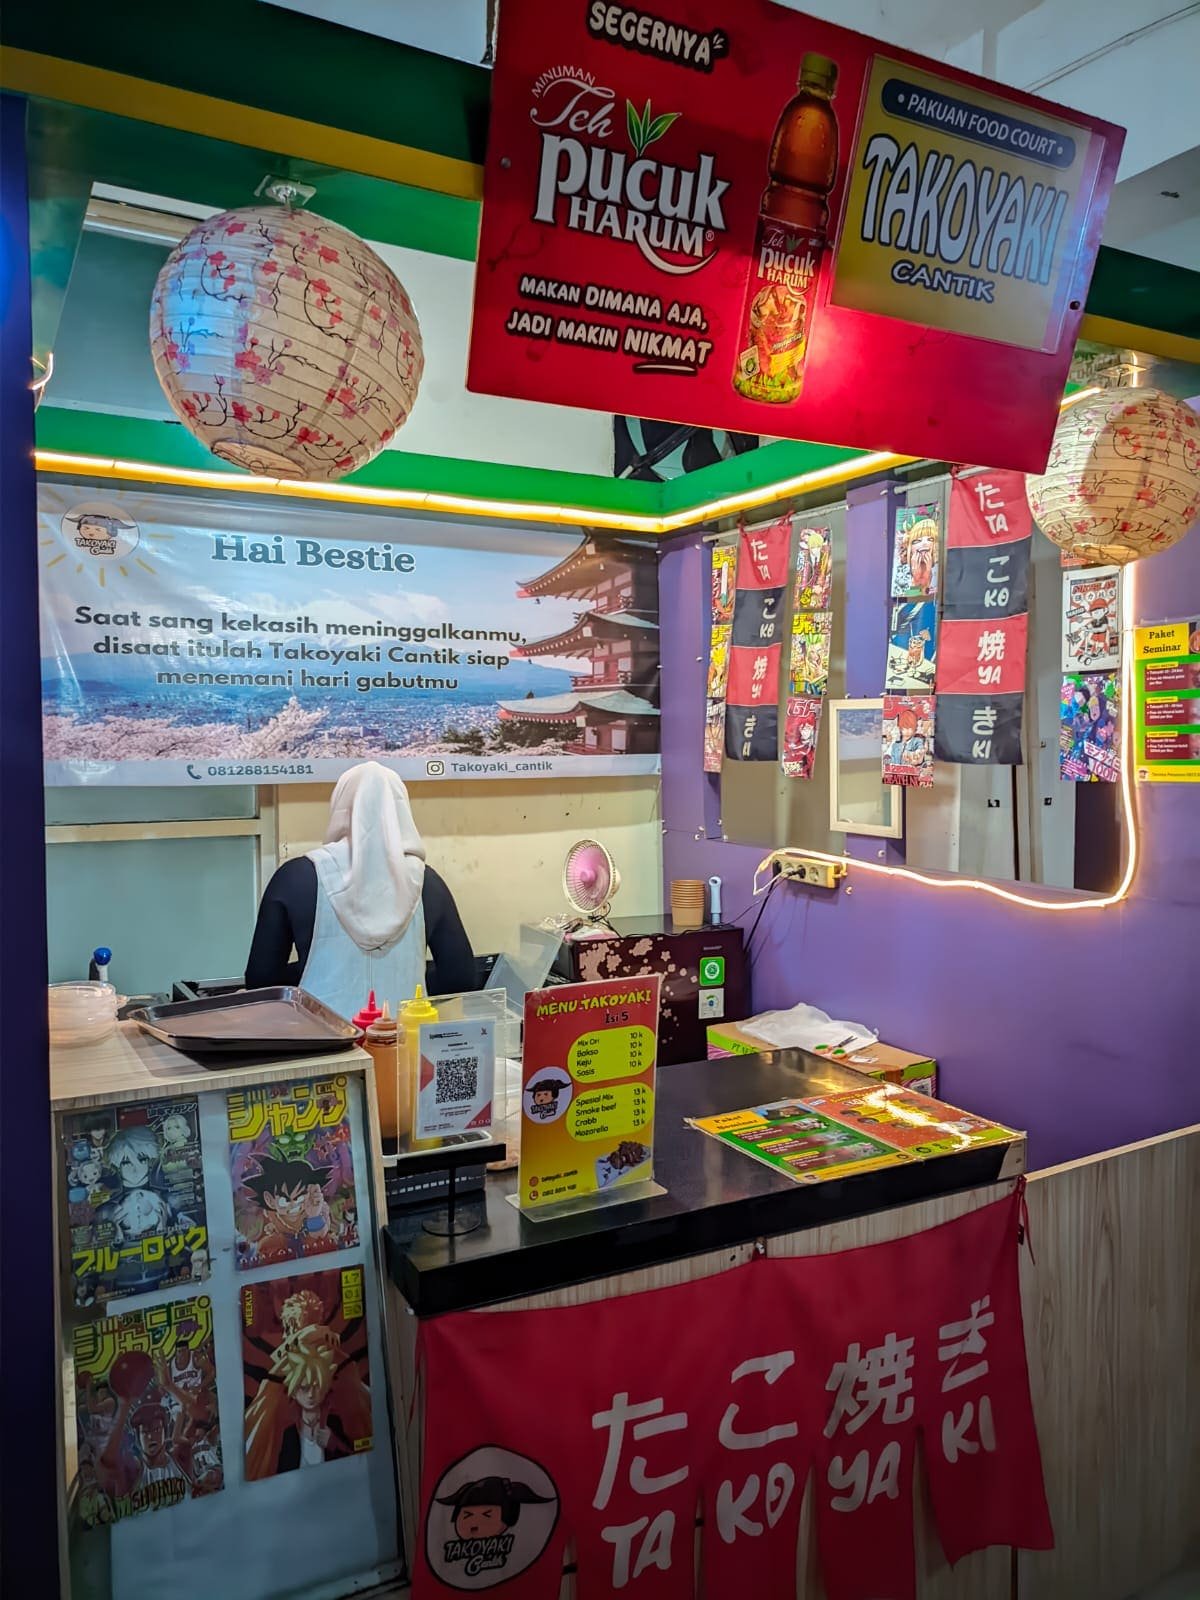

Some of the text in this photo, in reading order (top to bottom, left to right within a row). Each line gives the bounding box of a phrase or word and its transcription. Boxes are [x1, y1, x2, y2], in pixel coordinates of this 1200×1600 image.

[589, 2, 711, 65] SEGERNYA
[531, 65, 595, 99] MINUMAN
[530, 78, 615, 138] Teh
[907, 93, 1056, 156] PAKUAN FOOD COURT
[534, 133, 732, 231] pucuk
[864, 135, 1068, 285] TAKOYAKI
[567, 196, 719, 274] HARUM
[757, 246, 816, 278] pucuk
[767, 268, 809, 295] HARUM
[891, 261, 995, 303] CANTIK
[520, 276, 707, 331] MAKAN DIMANA AJA,
[507, 311, 712, 365] JADI MAKIN NIKMAT
[974, 482, 1005, 512] た
[984, 513, 1009, 535] TA
[211, 533, 415, 573] Hai Bestie
[751, 539, 768, 562] た
[987, 555, 1010, 583] こ
[763, 597, 776, 619] こ
[984, 587, 1010, 608] KO
[75, 605, 527, 645] Saat sang kekasih meninggalkanmu,
[1149, 630, 1175, 639] Paket
[93, 635, 510, 670] disaat itulah Takoyaki Cantik siap
[977, 629, 1006, 662] 焼
[1143, 644, 1181, 654] Seminar
[157, 669, 458, 692] menemani hari gabutmu
[977, 665, 1002, 684] YA
[972, 706, 997, 735] き
[972, 739, 992, 759] KI
[207, 764, 314, 777] 081288154181
[451, 761, 553, 773] Takoyaki_cantik
[536, 990, 652, 1017] MENU TAKOYAKI
[605, 1011, 629, 1023] Isi 5
[576, 1059, 592, 1067] Keju
[576, 1107, 600, 1116] Smoke
[72, 1226, 207, 1278] ブルーロック
[591, 1391, 689, 1511] た
[718, 1350, 798, 1450] こ
[823, 1332, 915, 1439] 焼
[601, 1395, 996, 1589] TA KO YA KI
[446, 1535, 514, 1561] TAKOYAKI
